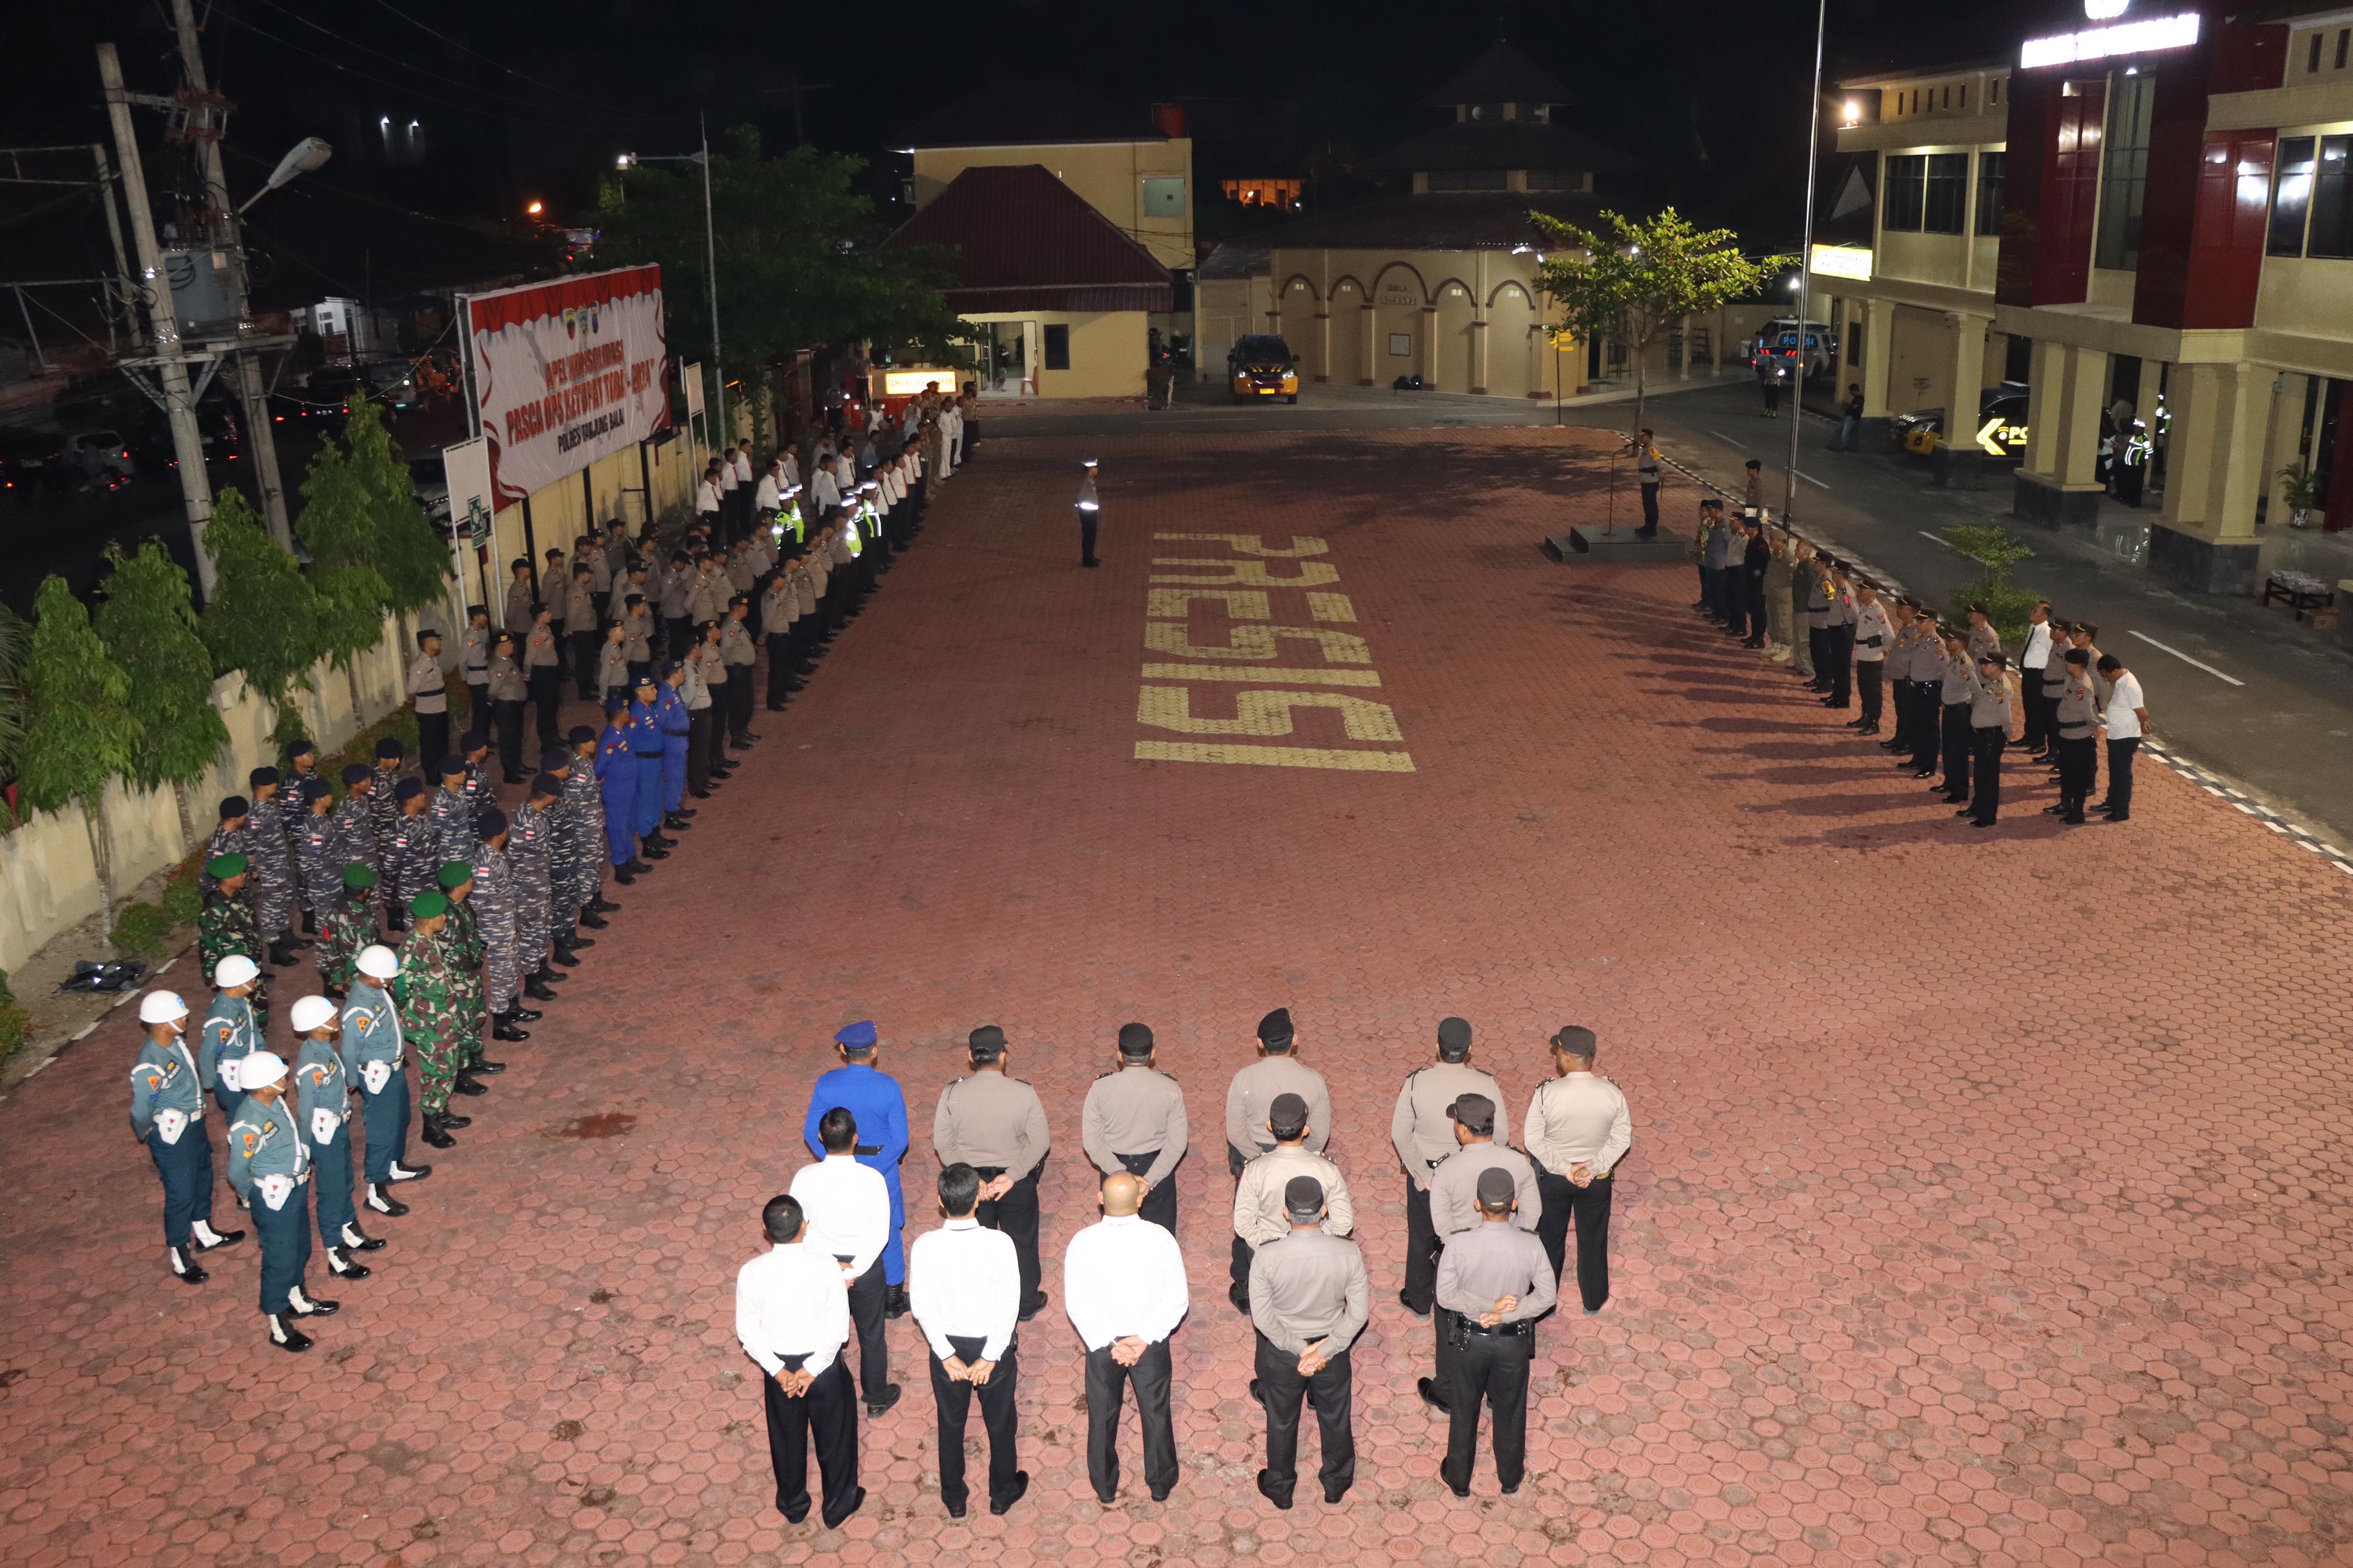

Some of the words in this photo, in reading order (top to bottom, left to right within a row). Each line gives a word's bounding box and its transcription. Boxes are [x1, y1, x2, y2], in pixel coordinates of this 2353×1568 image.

[545, 358, 567, 390] APEL
[568, 339, 625, 381] KONSOLIDASI
[506, 400, 544, 447] PASCA
[544, 392, 564, 431] OPS
[564, 377, 603, 422] KETUPAT
[558, 429, 581, 454] POLRES
[581, 414, 609, 442] TANJUNG
[609, 407, 625, 430] BALAI
[1134, 532, 1417, 772] PRESISI
